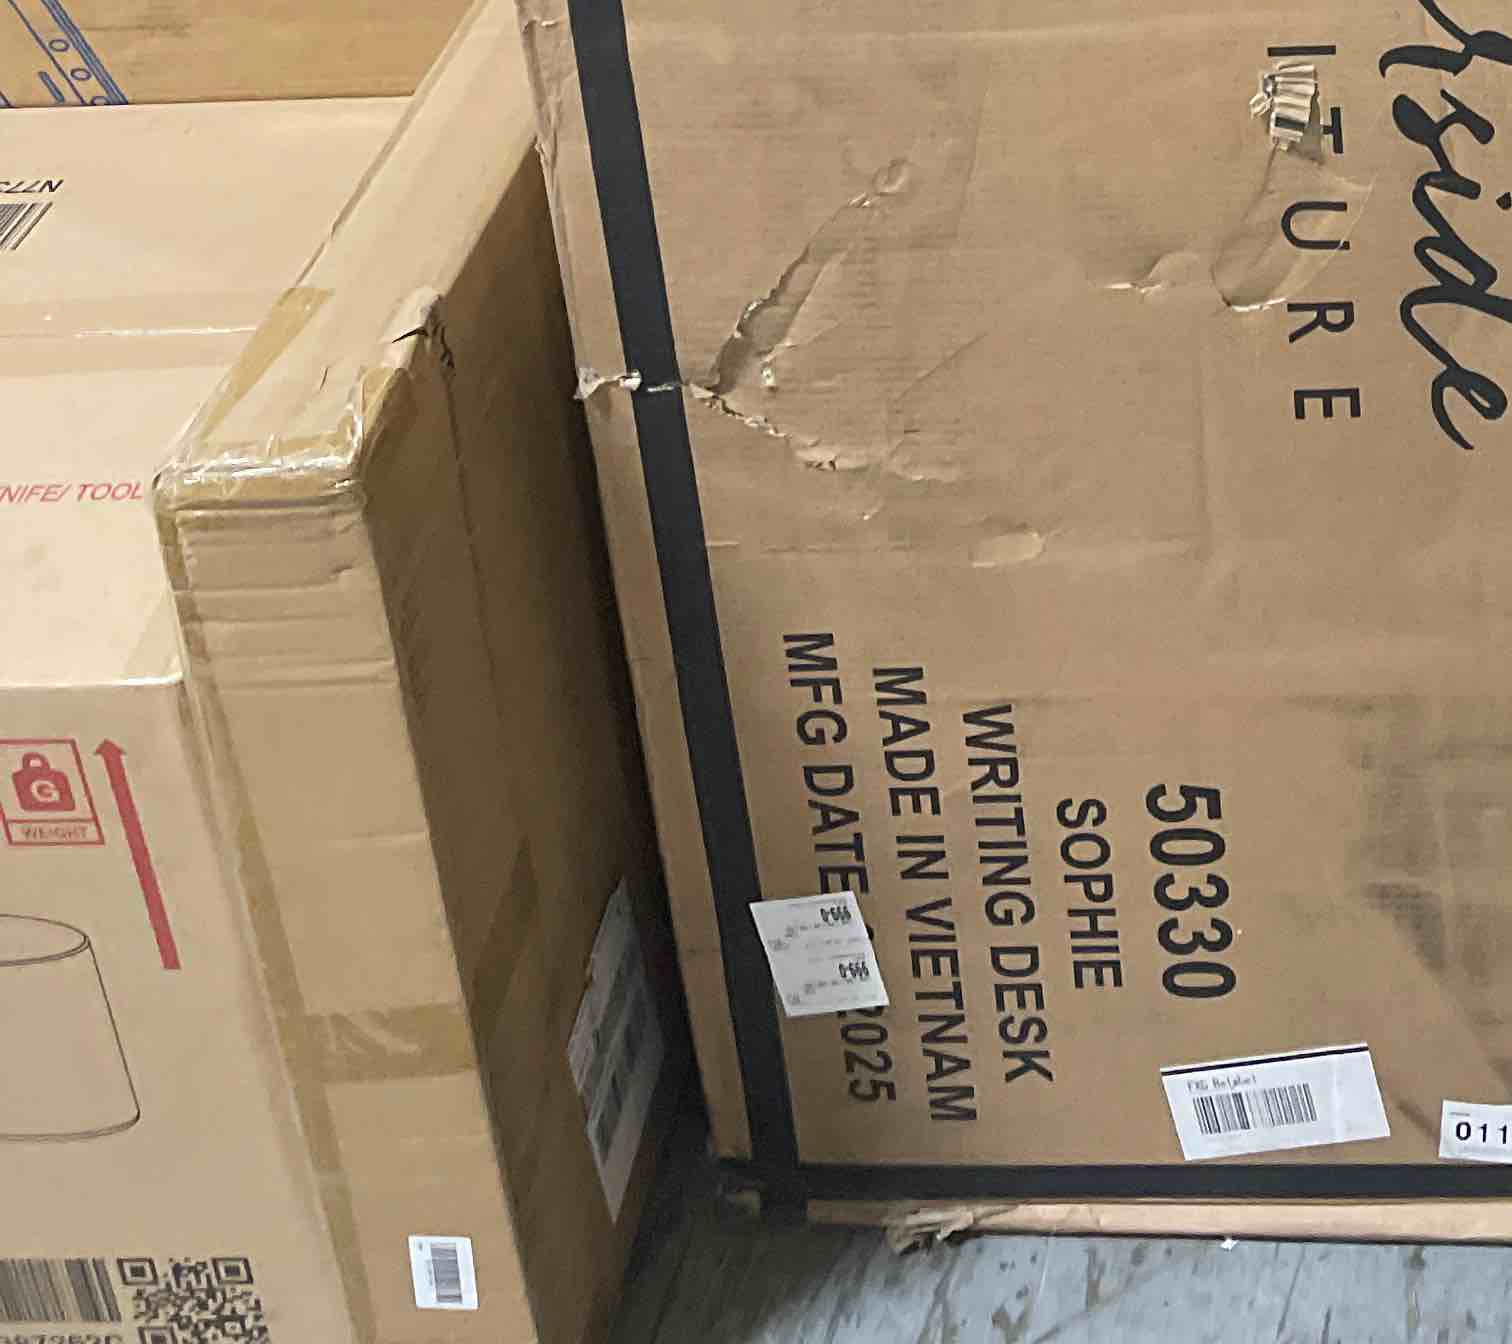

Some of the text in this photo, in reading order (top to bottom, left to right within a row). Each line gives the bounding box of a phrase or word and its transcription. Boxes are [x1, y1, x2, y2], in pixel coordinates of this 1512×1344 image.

[78, 482, 144, 502] TOOL
[783, 631, 848, 747] MFG
[21, 826, 89, 841] WEIGHT
[872, 666, 977, 1121] MADE IN VIETNAM
[962, 703, 1054, 1083] WRITING DESK
[1056, 798, 1122, 989] SOPHIE
[1146, 783, 1237, 999] 50330
